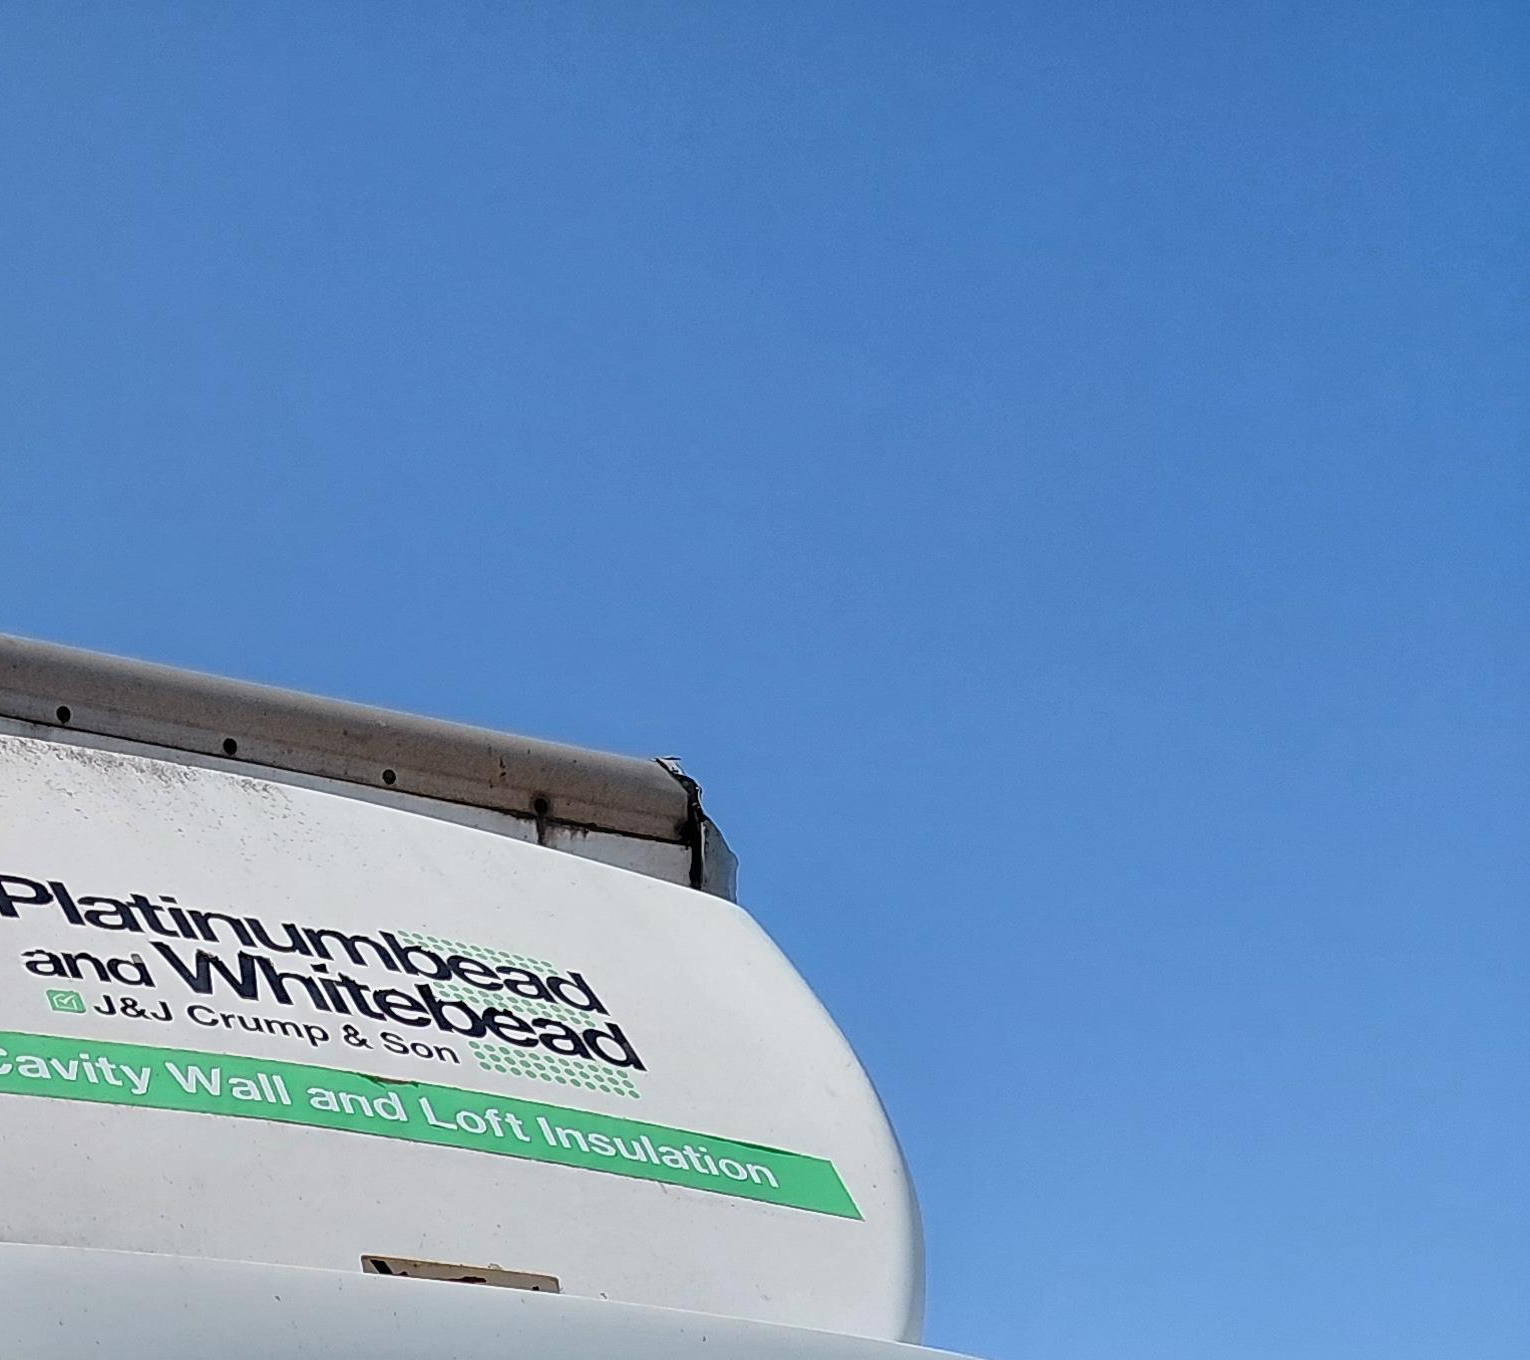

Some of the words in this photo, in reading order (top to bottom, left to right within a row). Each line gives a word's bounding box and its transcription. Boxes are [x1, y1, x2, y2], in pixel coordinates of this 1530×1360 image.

[23, 944, 157, 988] and
[150, 944, 647, 1072] Whitebead
[93, 992, 175, 1024] J&J
[188, 1003, 330, 1048] Crump
[343, 1021, 372, 1049] &
[381, 1028, 461, 1065] Son
[175, 1064, 291, 1108] Wall
[305, 1078, 408, 1125] and
[420, 1092, 529, 1144] Loft
[536, 1116, 778, 1189] Insulation
